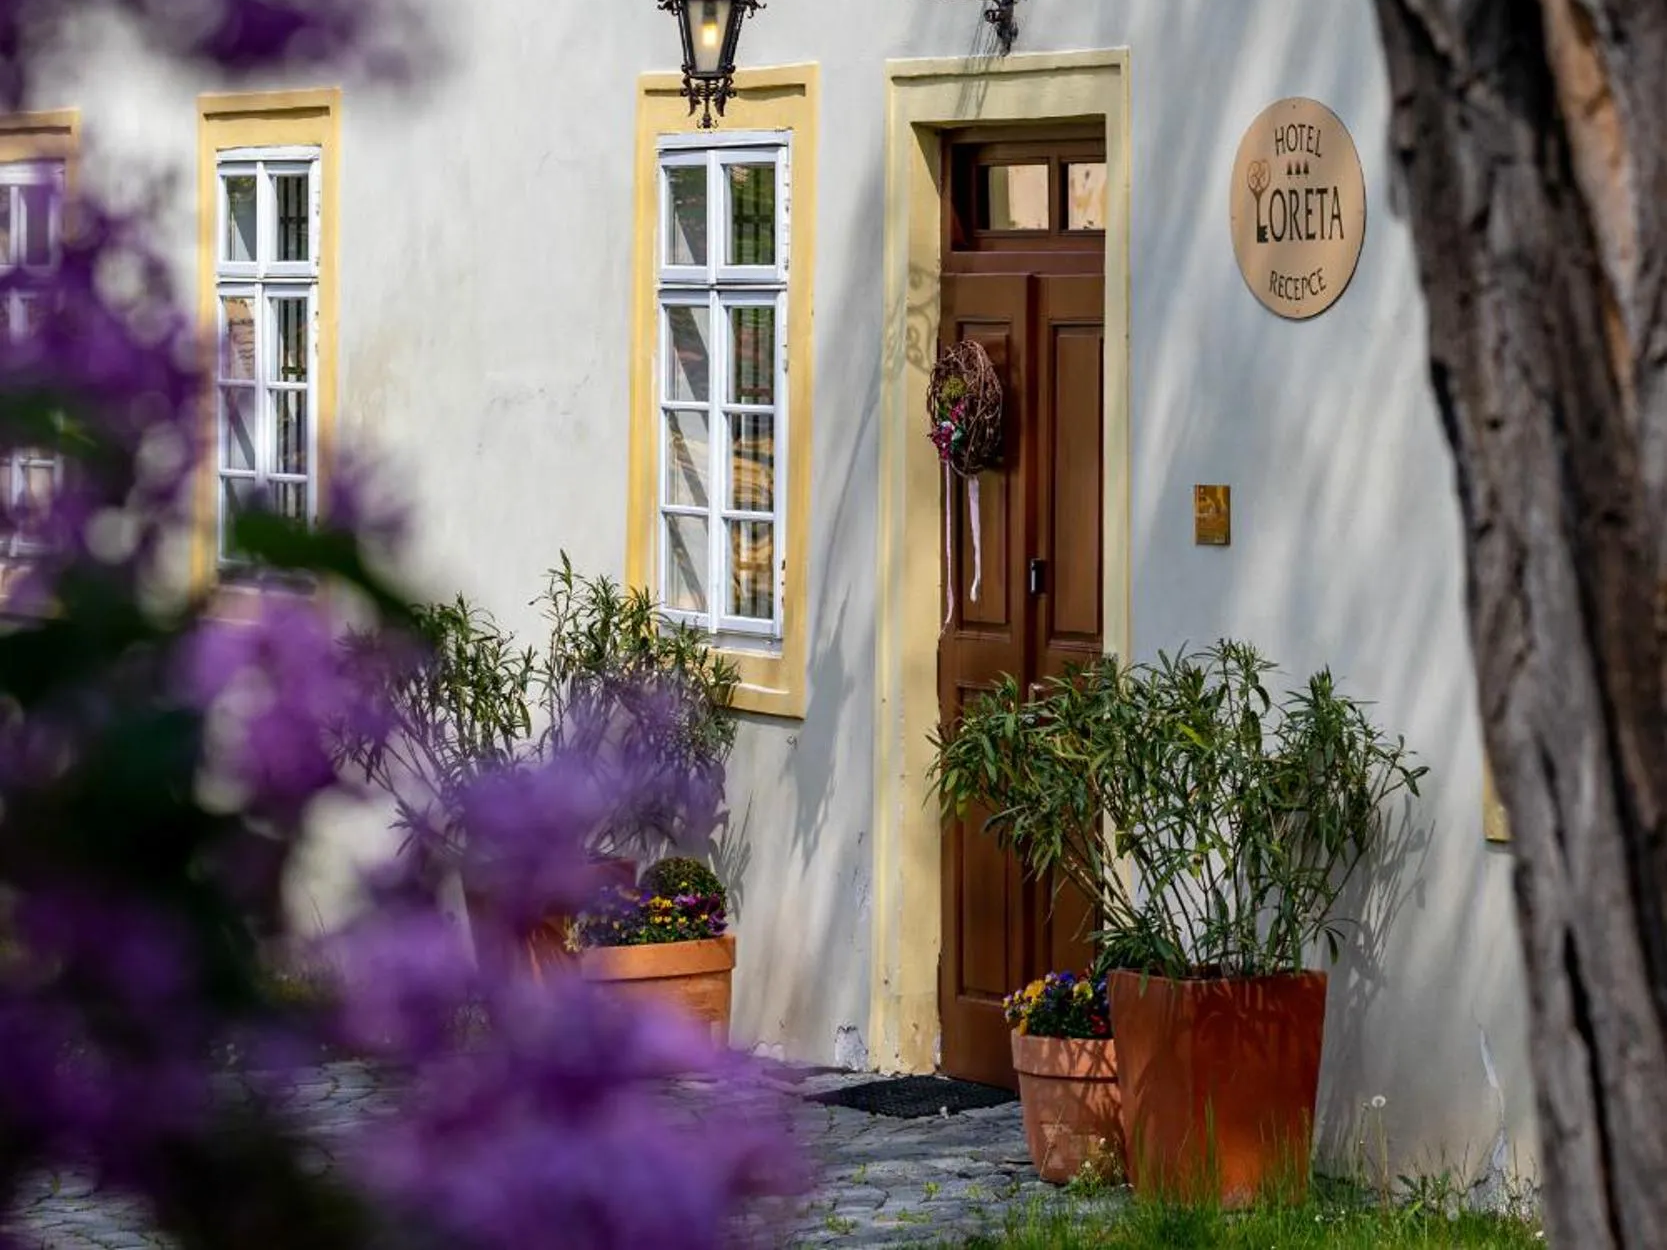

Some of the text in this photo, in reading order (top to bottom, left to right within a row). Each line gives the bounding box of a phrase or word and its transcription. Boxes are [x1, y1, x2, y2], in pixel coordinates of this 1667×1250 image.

[1275, 124, 1322, 158] HOTEL
[1253, 183, 1345, 243] LORETA
[1269, 268, 1327, 301] RECEPCE
